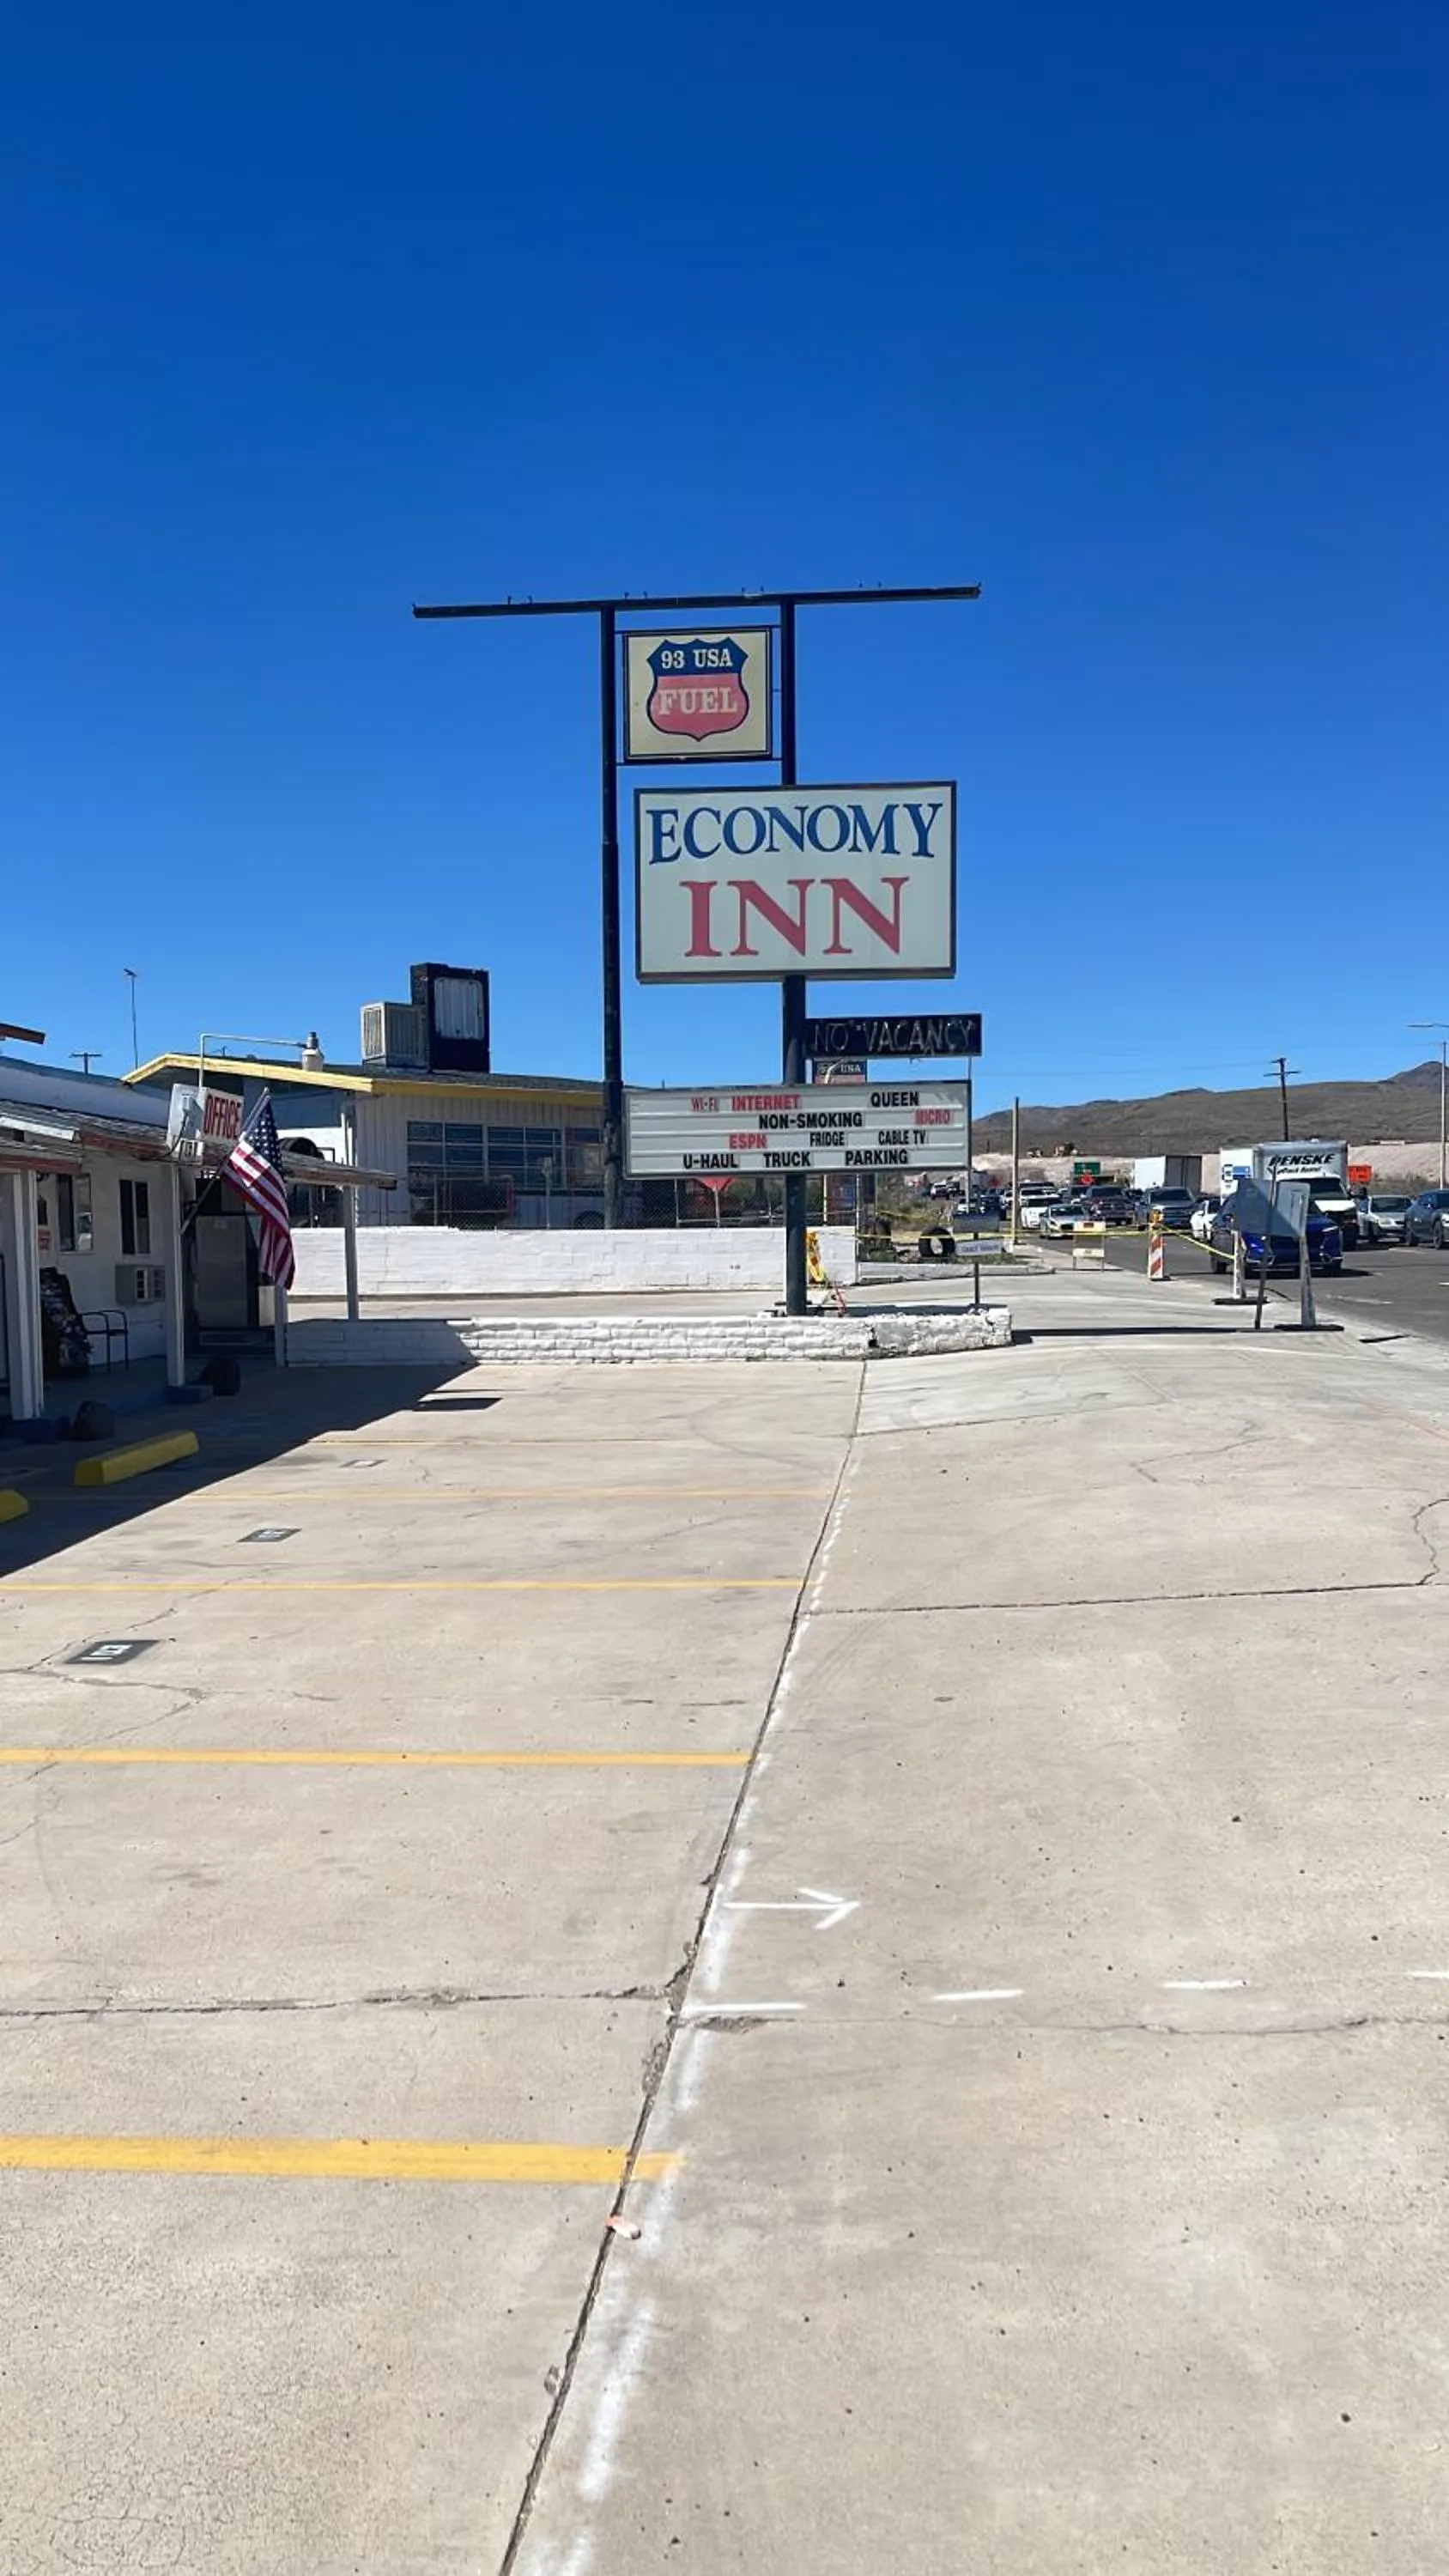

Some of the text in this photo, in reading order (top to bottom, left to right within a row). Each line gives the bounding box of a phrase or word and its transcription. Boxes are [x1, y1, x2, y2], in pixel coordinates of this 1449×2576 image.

[661, 648, 733, 669] 93 USA
[658, 687, 737, 714] FUEL
[646, 804, 943, 865] ECONOMY
[679, 876, 910, 957] INN
[815, 1020, 976, 1054] NO VACANCY
[732, 1095, 802, 1110] INTERNET
[870, 1092, 919, 1107] QUEEN
[203, 1094, 240, 1139] OFFICE
[759, 1109, 950, 1129] NON-SMOKING MICRO
[730, 1130, 925, 1148] ESPN FRIDGE CABLE TV
[683, 1149, 908, 1169] U-HAUL TRUCK PARKING
[1269, 1154, 1336, 1166] PENSKE
